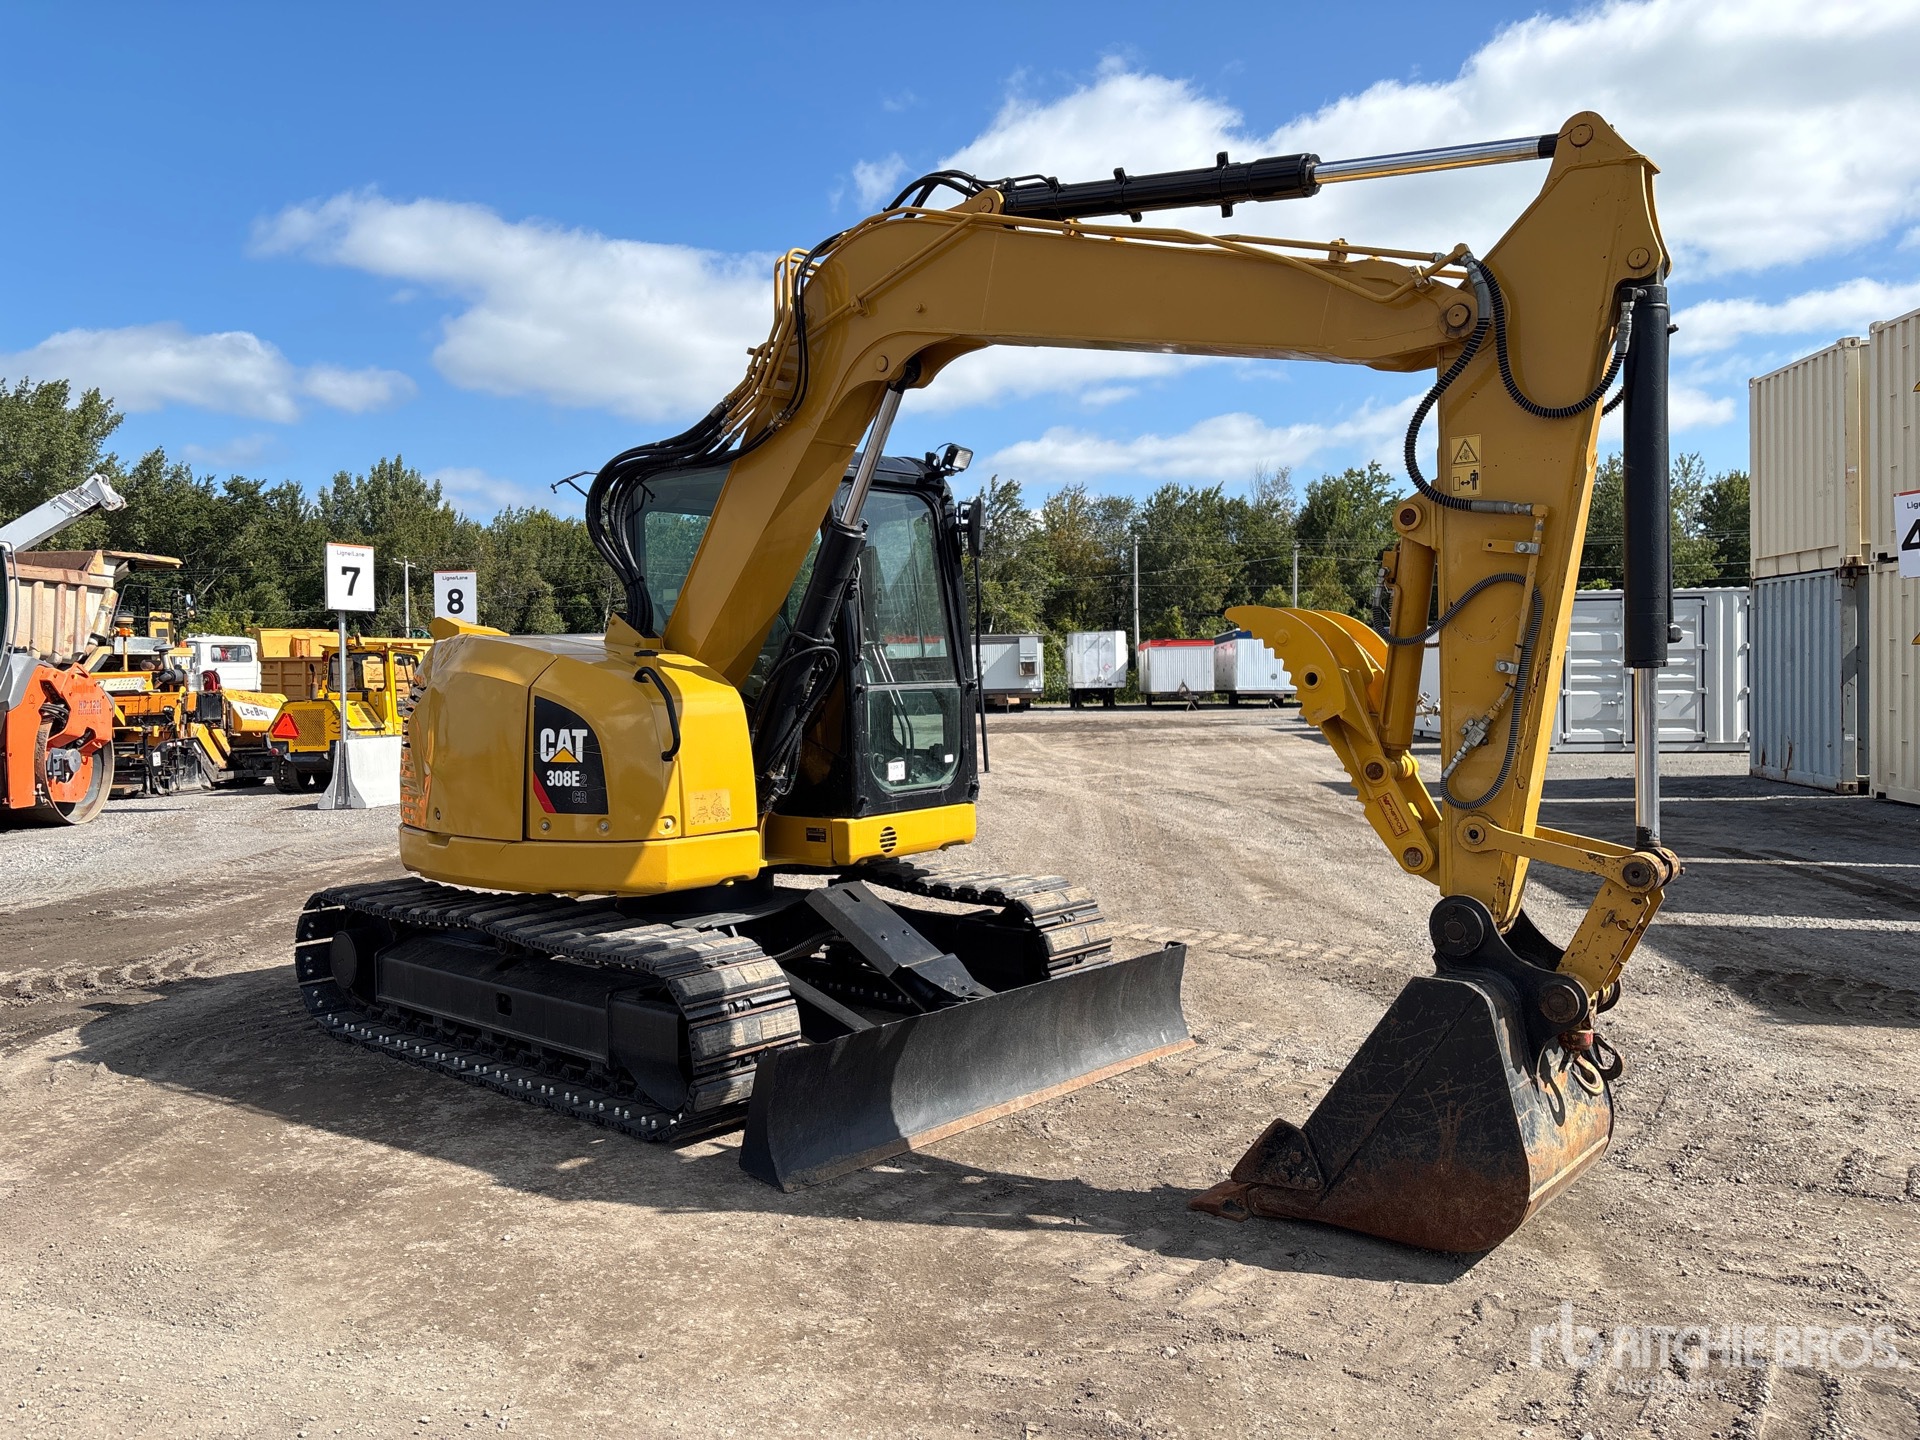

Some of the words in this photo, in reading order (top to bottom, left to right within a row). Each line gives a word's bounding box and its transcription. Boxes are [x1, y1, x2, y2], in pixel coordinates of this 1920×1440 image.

[1901, 519, 1920, 551] 4
[336, 549, 365, 558] Ligne/Lane
[341, 566, 361, 596] 7
[447, 588, 464, 614] 8
[239, 705, 269, 719] LeeBoy
[540, 728, 588, 763] CAT
[571, 790, 588, 804] CR
